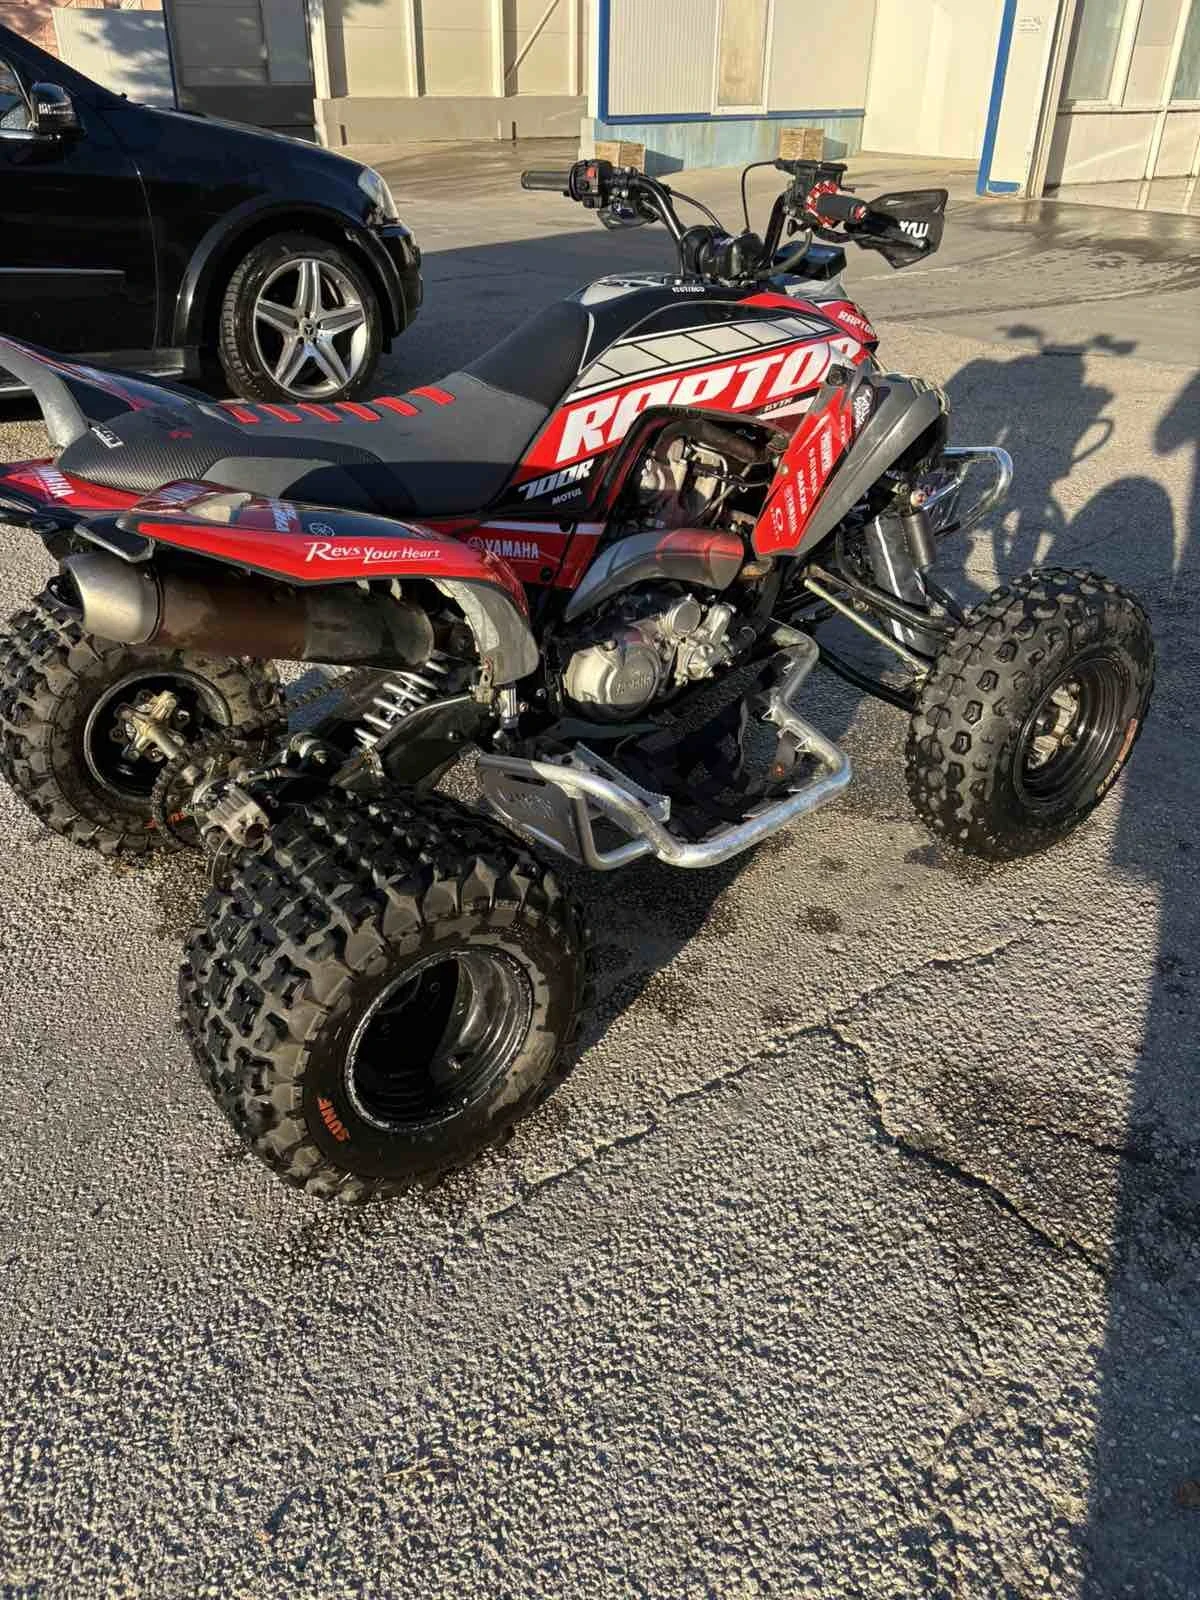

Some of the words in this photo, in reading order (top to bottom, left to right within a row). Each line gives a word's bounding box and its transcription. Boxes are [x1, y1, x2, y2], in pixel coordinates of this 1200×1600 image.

[518, 458, 595, 501] 700R
[552, 487, 583, 505] MOTUL
[362, 546, 402, 565] Your
[401, 547, 441, 560] Heart
[484, 539, 539, 560] YAMAHA
